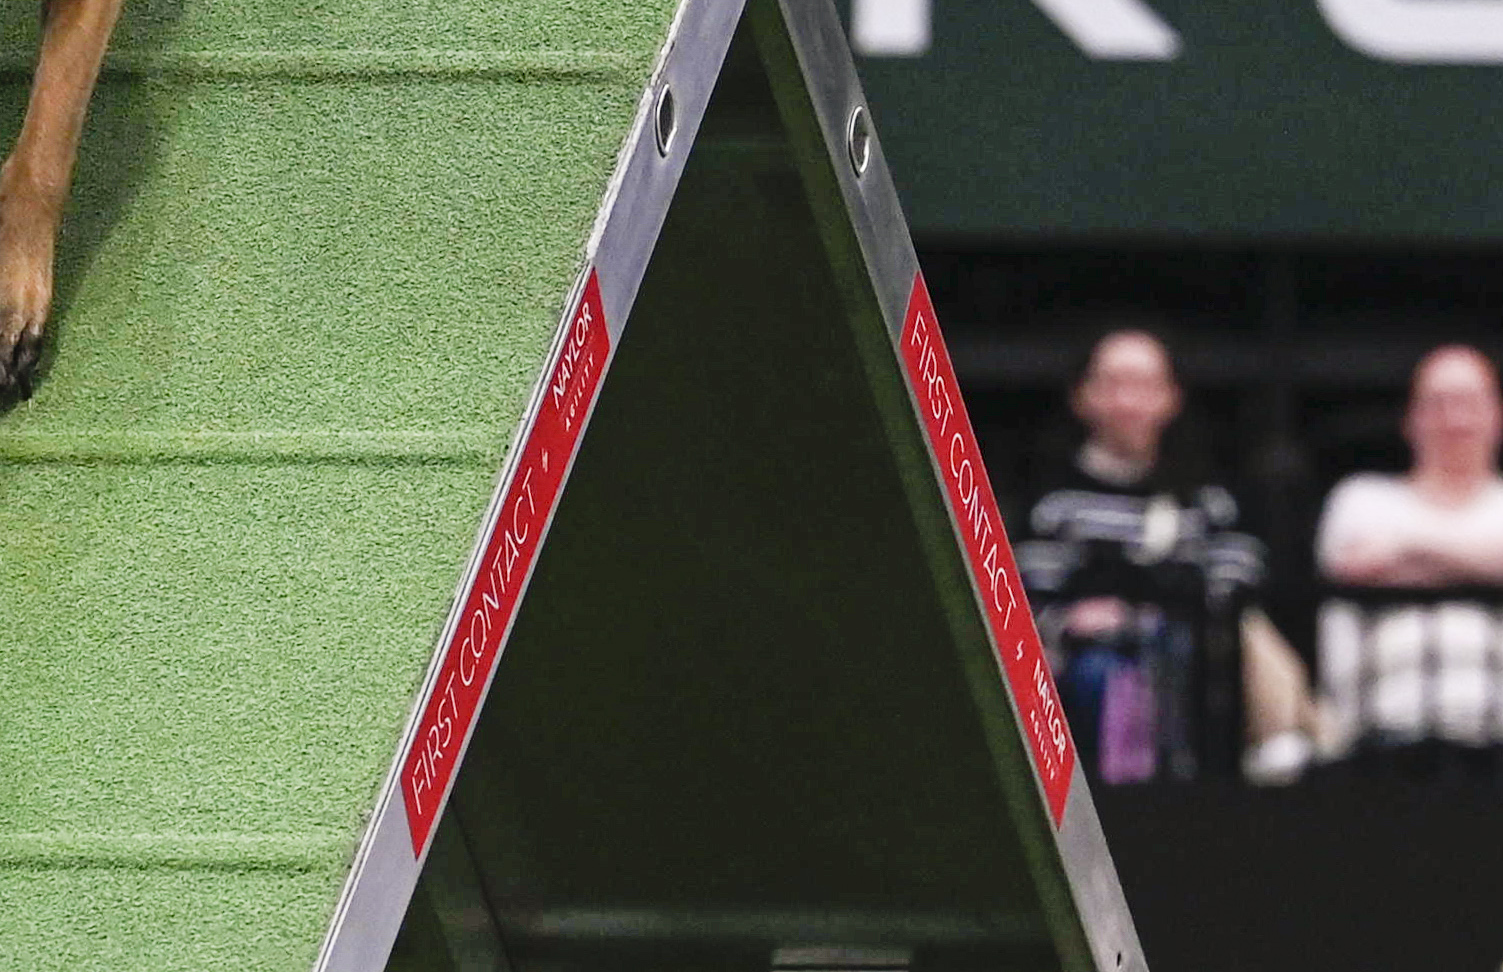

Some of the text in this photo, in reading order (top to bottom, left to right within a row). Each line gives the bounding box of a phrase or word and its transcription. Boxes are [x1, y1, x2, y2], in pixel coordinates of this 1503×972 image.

[552, 301, 594, 410] NAYLOR
[564, 352, 595, 433] AGILITY
[910, 310, 1018, 631] FIRST CONTACT
[411, 466, 536, 816] FIRST CONTACT
[1033, 658, 1067, 765] NAYLOR
